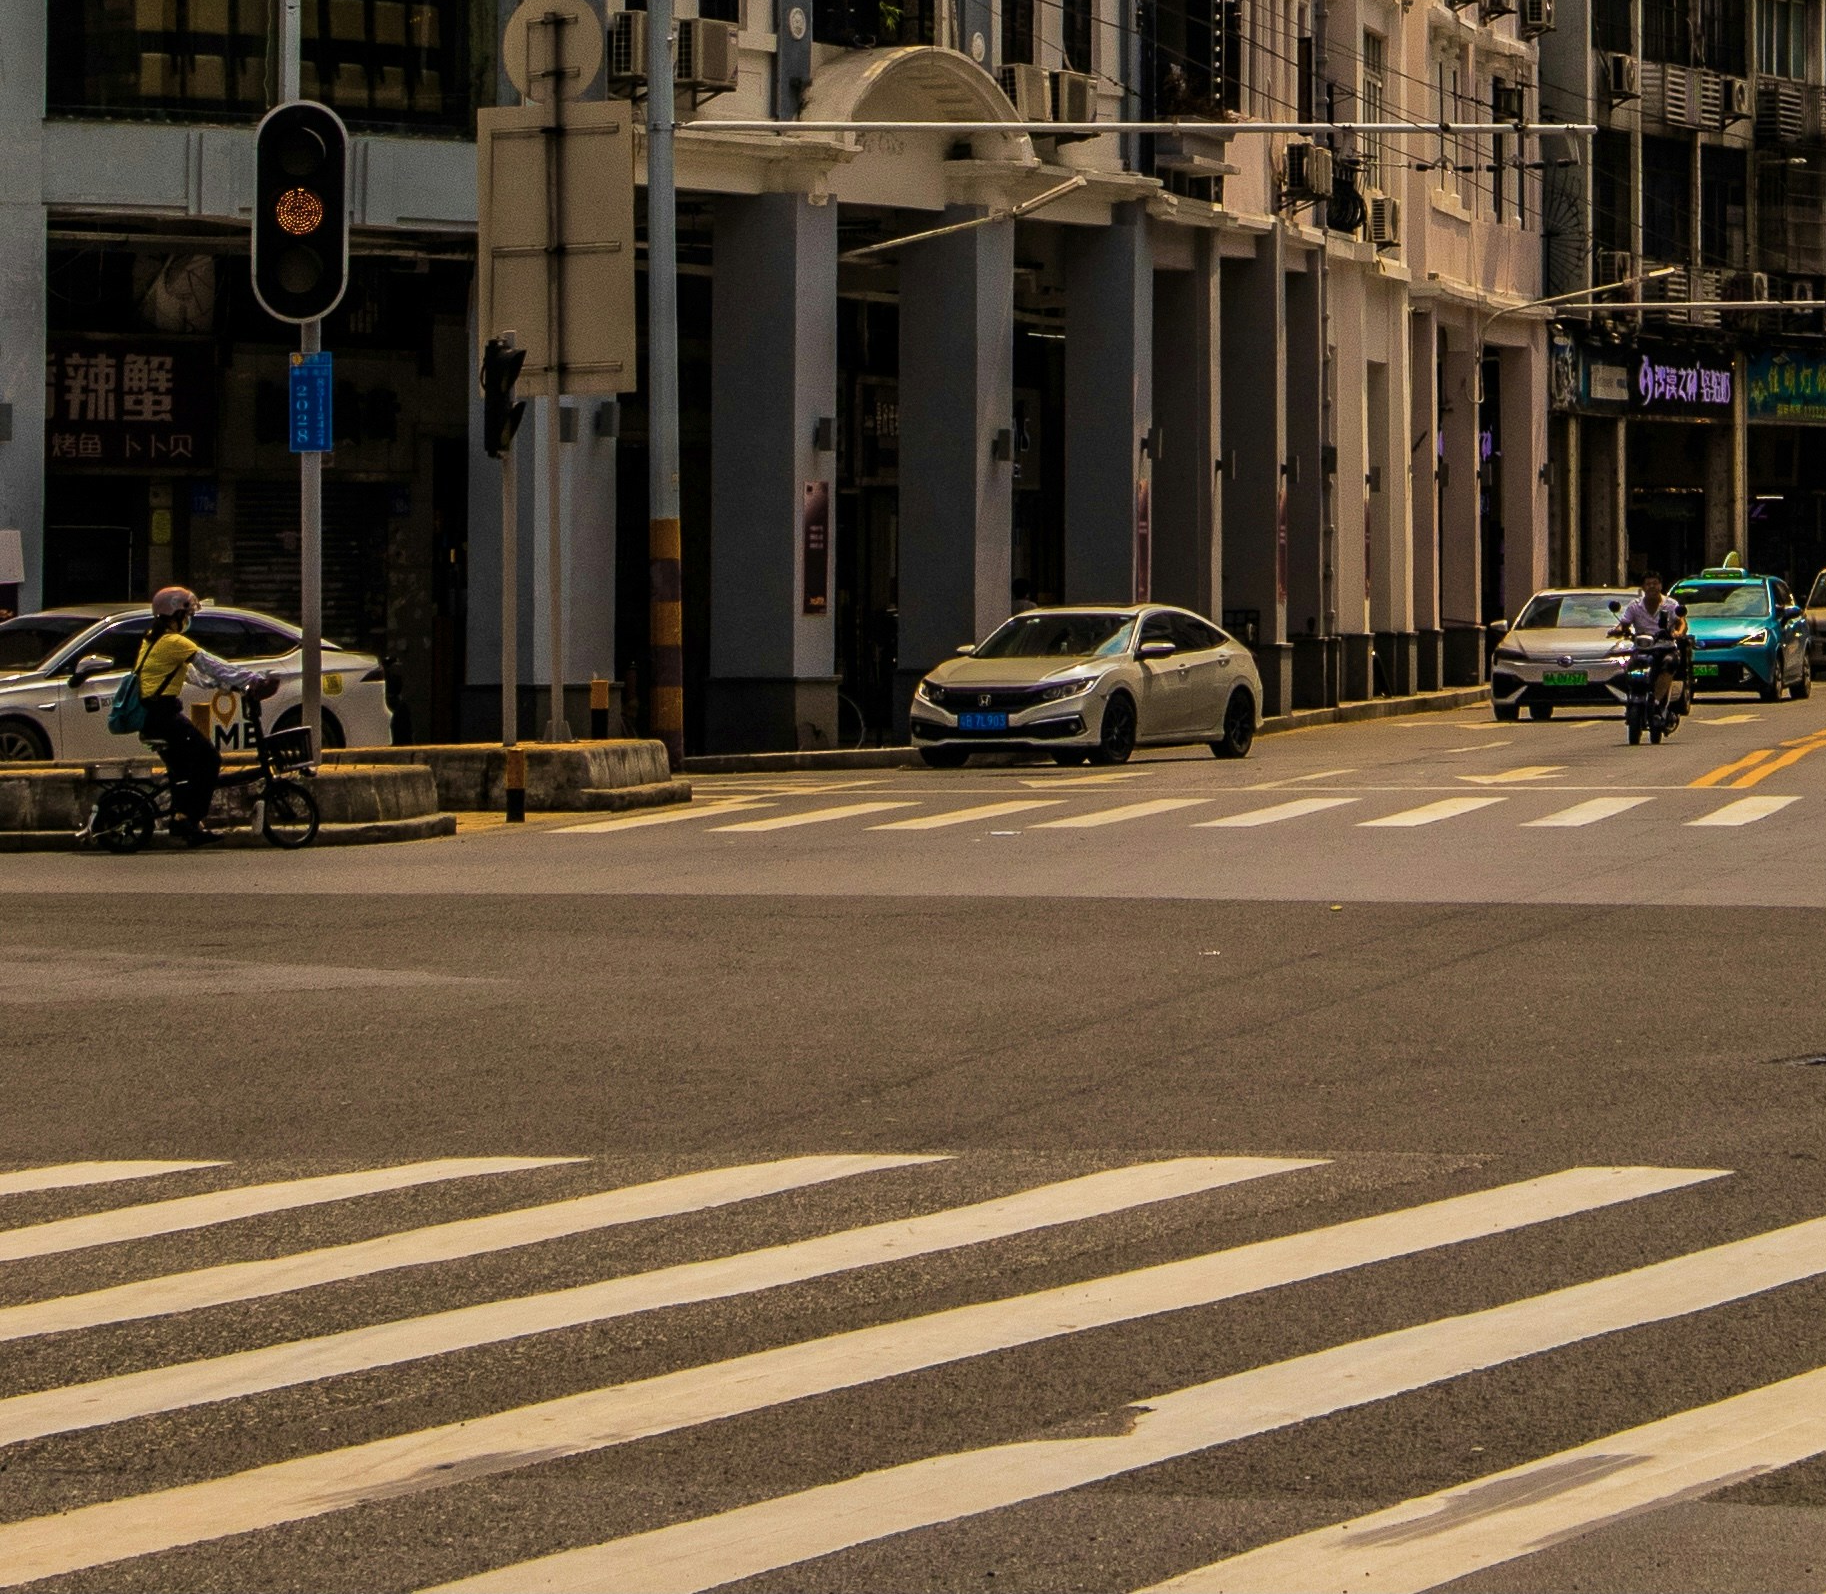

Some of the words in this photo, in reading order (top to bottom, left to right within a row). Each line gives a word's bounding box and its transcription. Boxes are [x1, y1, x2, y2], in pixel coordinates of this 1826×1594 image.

[296, 384, 309, 444] 2028
[51, 432, 104, 458] 烤鱼
[124, 433, 193, 459] 卜卜贝
